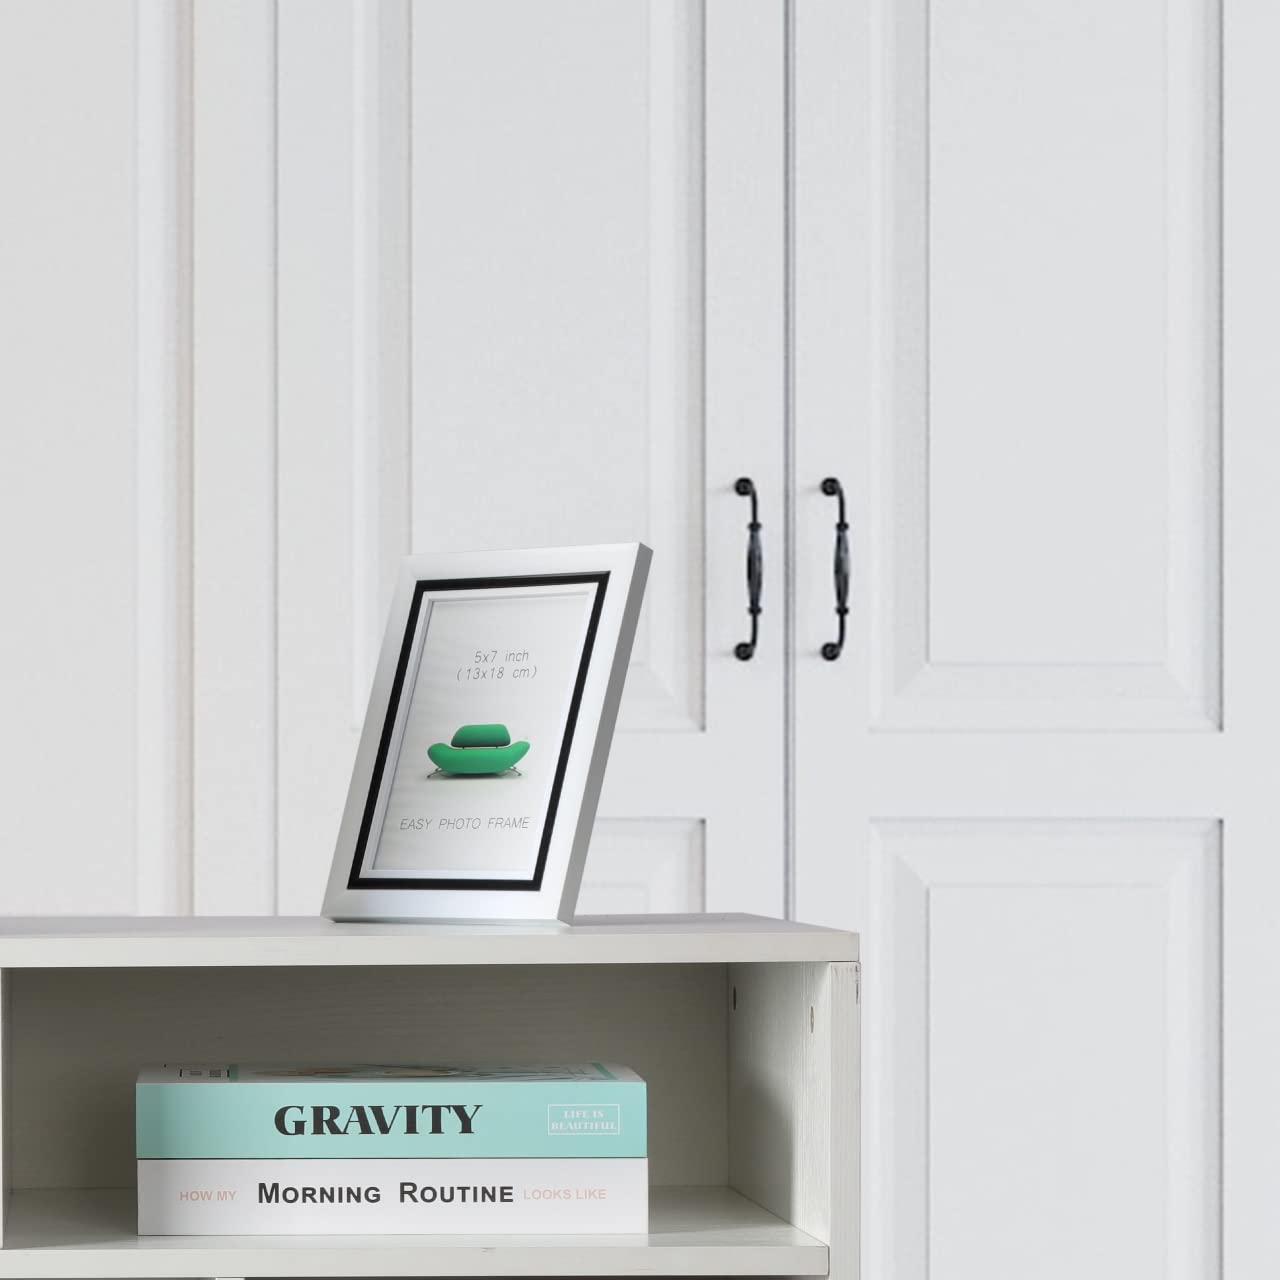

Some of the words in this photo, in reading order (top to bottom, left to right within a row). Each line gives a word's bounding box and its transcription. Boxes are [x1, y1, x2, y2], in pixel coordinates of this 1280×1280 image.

[474, 651, 498, 664] 5x7
[504, 650, 530, 663] inch
[512, 666, 538, 680] cm)
[400, 818, 433, 831] EASY
[438, 817, 482, 830] PHOTO
[487, 817, 531, 830] FRAME
[273, 1104, 483, 1136] GRAVITY
[563, 1110, 589, 1119] LIFE
[592, 1110, 605, 1119] IS
[551, 1121, 617, 1131] BEAUTIFUL
[179, 1190, 213, 1202] HOW
[216, 1190, 238, 1202] MY
[523, 1188, 572, 1201] LOOKS
[576, 1188, 608, 1201] LIKE
